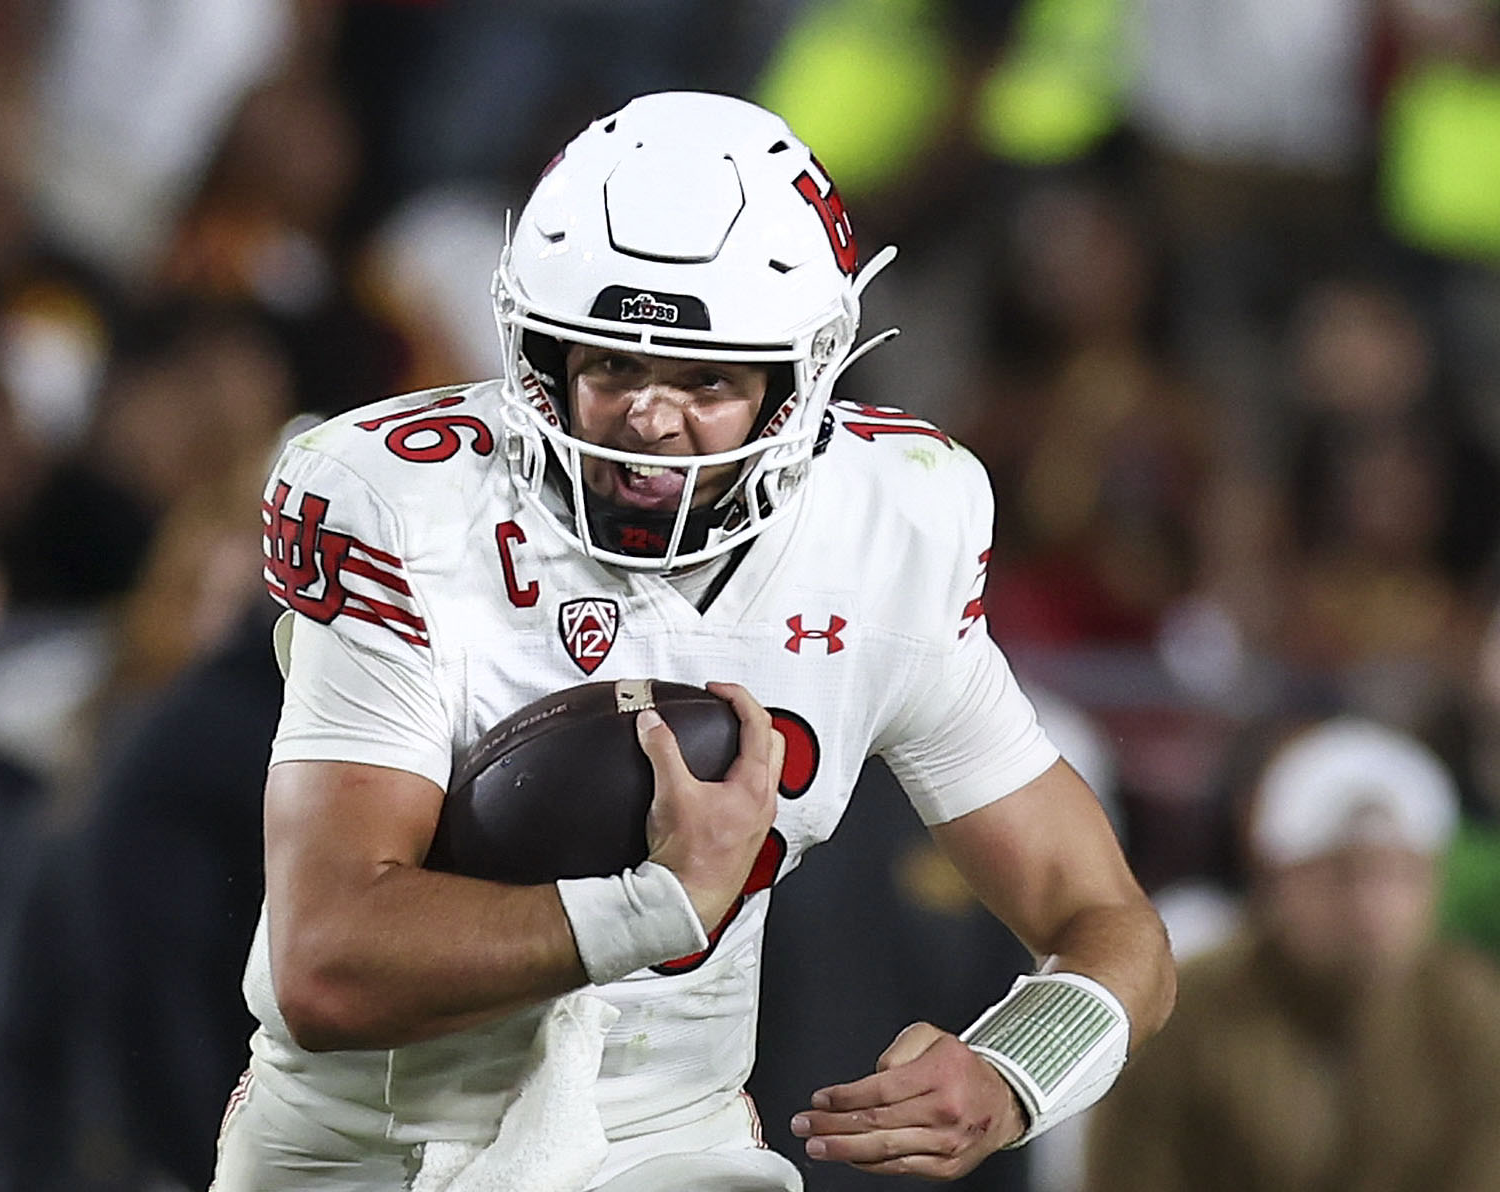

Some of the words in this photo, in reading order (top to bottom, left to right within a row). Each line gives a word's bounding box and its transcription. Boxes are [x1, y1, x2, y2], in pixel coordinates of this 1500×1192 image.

[353, 395, 495, 464] 16
[494, 519, 541, 609] C
[575, 629, 606, 659] 12
